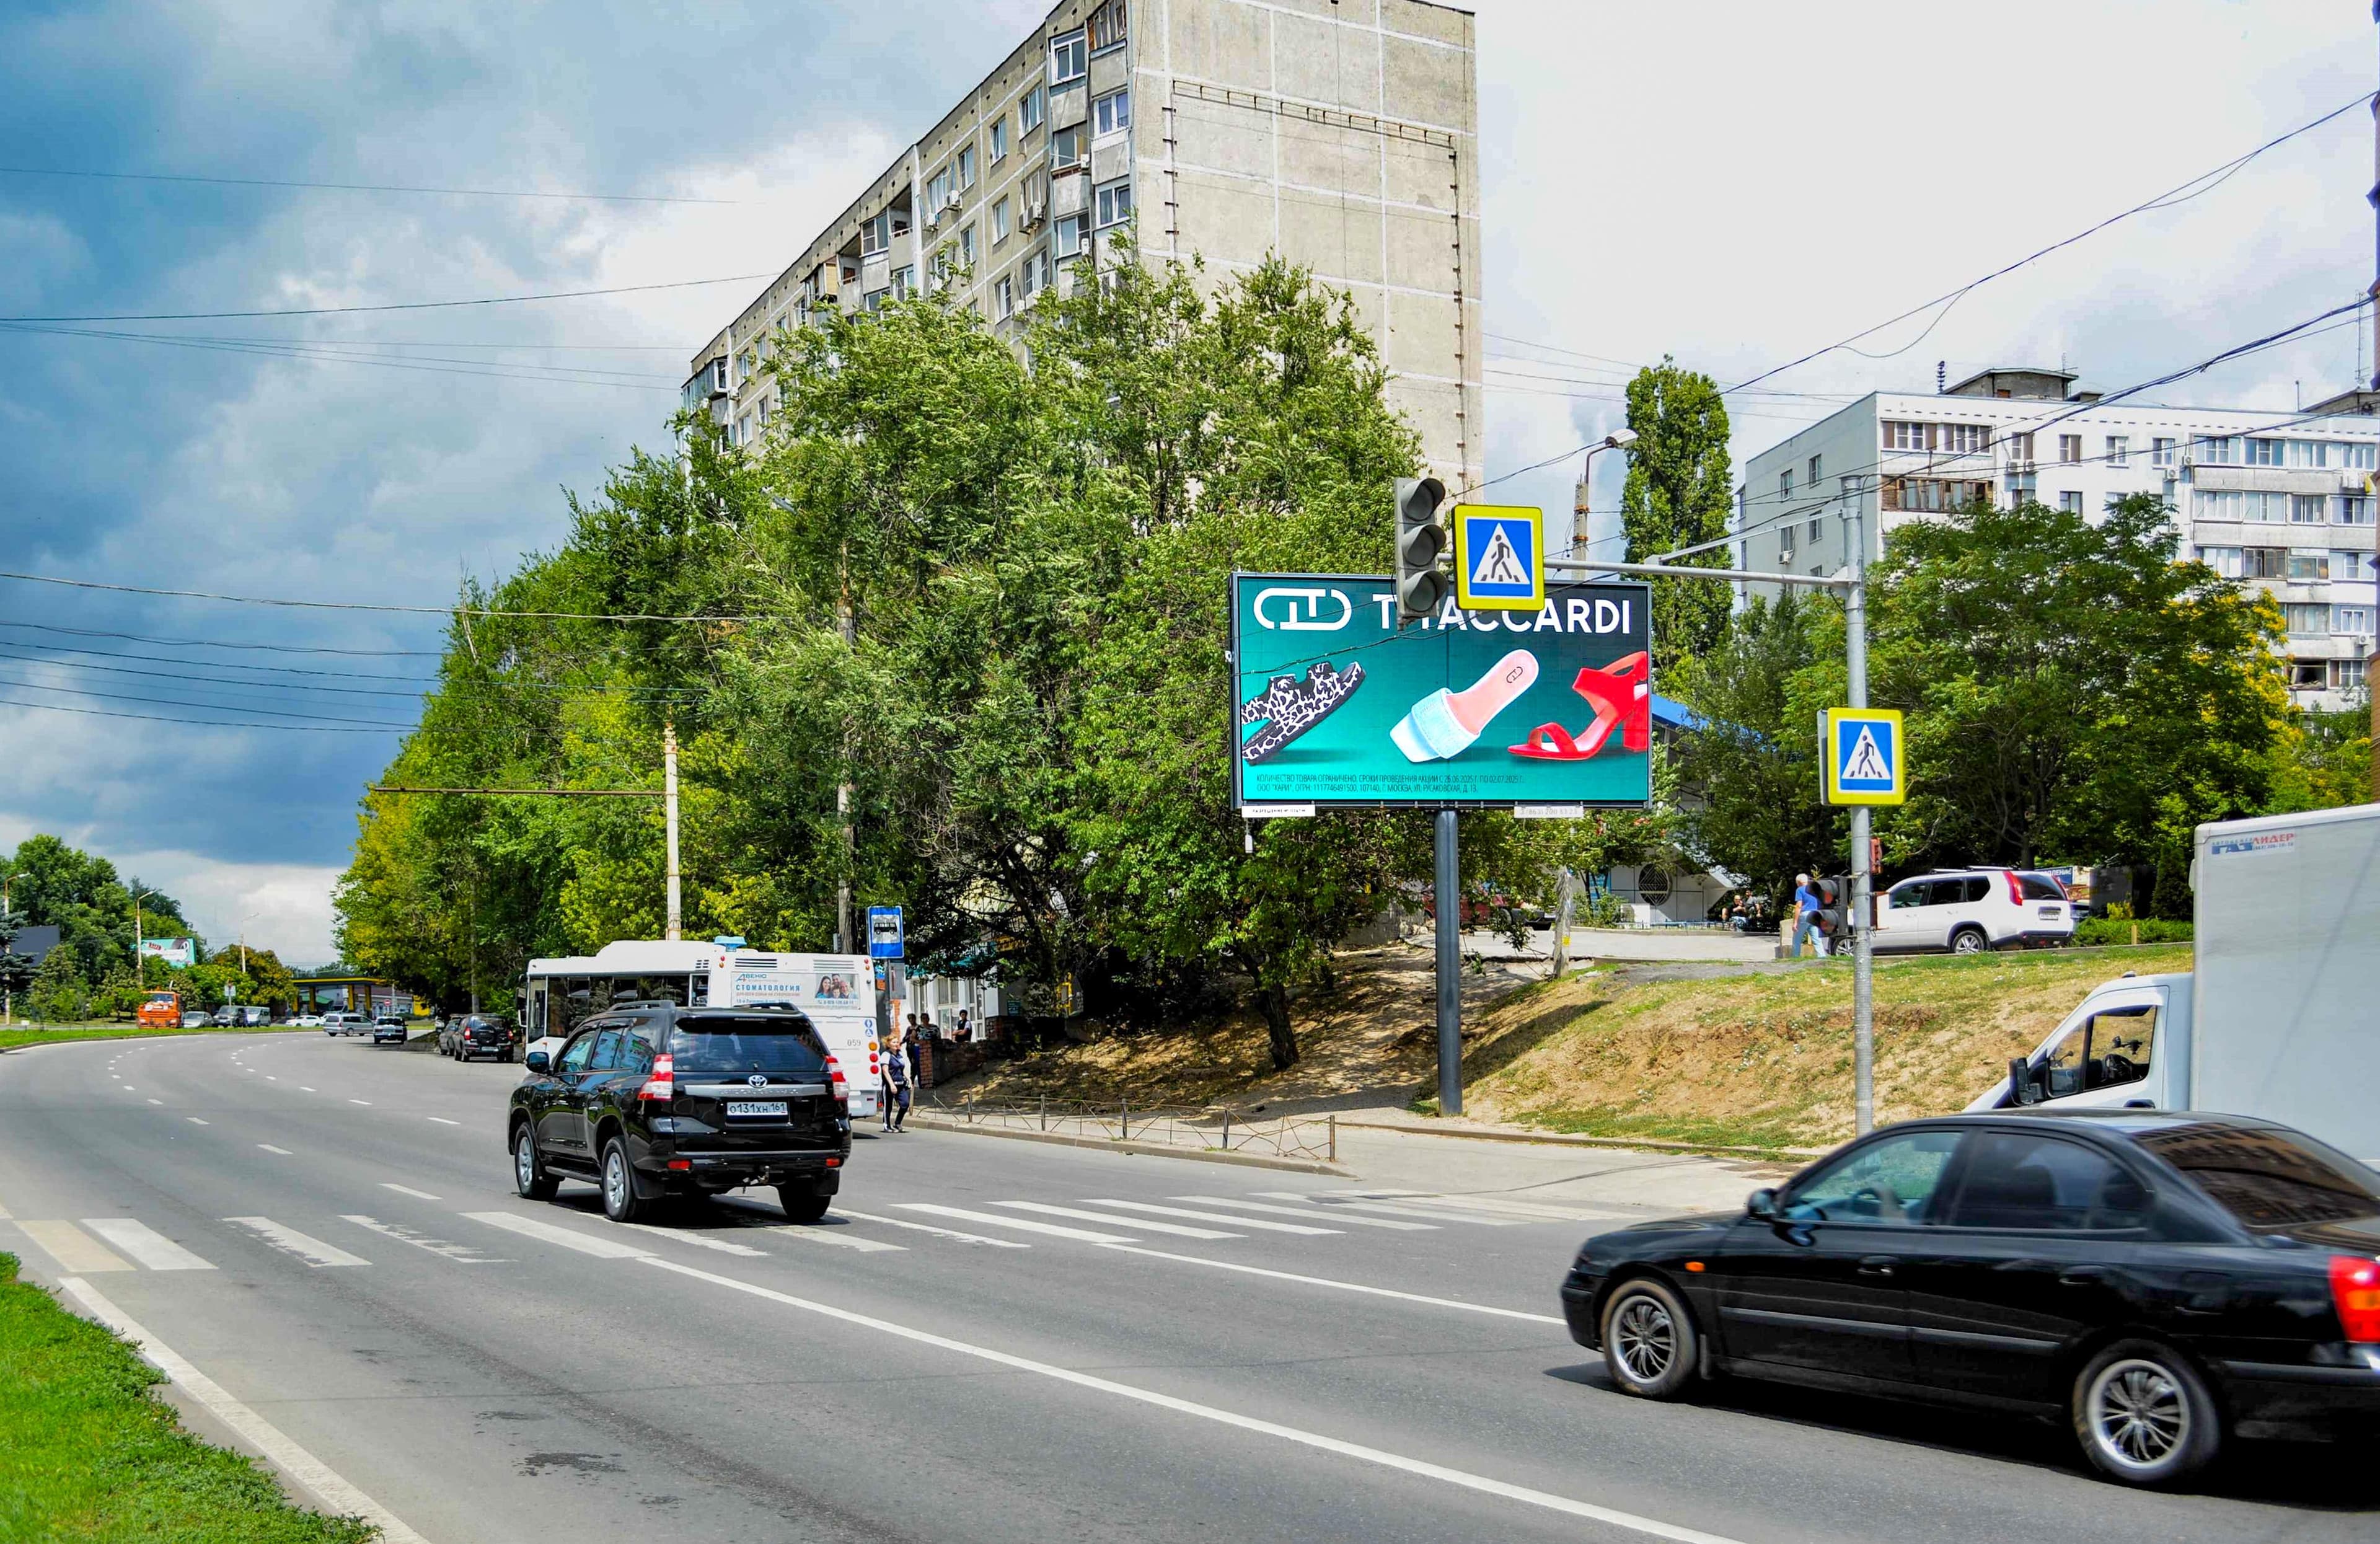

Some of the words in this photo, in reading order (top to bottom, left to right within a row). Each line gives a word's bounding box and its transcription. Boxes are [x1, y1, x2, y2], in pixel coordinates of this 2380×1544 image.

[1257, 774, 1295, 782] КОЛИЧЕСТВО
[1296, 774, 1317, 782] ТОВАРА
[1359, 774, 1378, 782] СРОКИ
[1379, 775, 1417, 783] ПРОВЕДЕНИЯ
[1479, 775, 1488, 783] ПО
[2253, 833, 2294, 844] ЛИДЕР
[2211, 842, 2252, 855] ГАЗ
[736, 973, 767, 982] АВЕНЮ
[770, 1103, 785, 1111] 161
